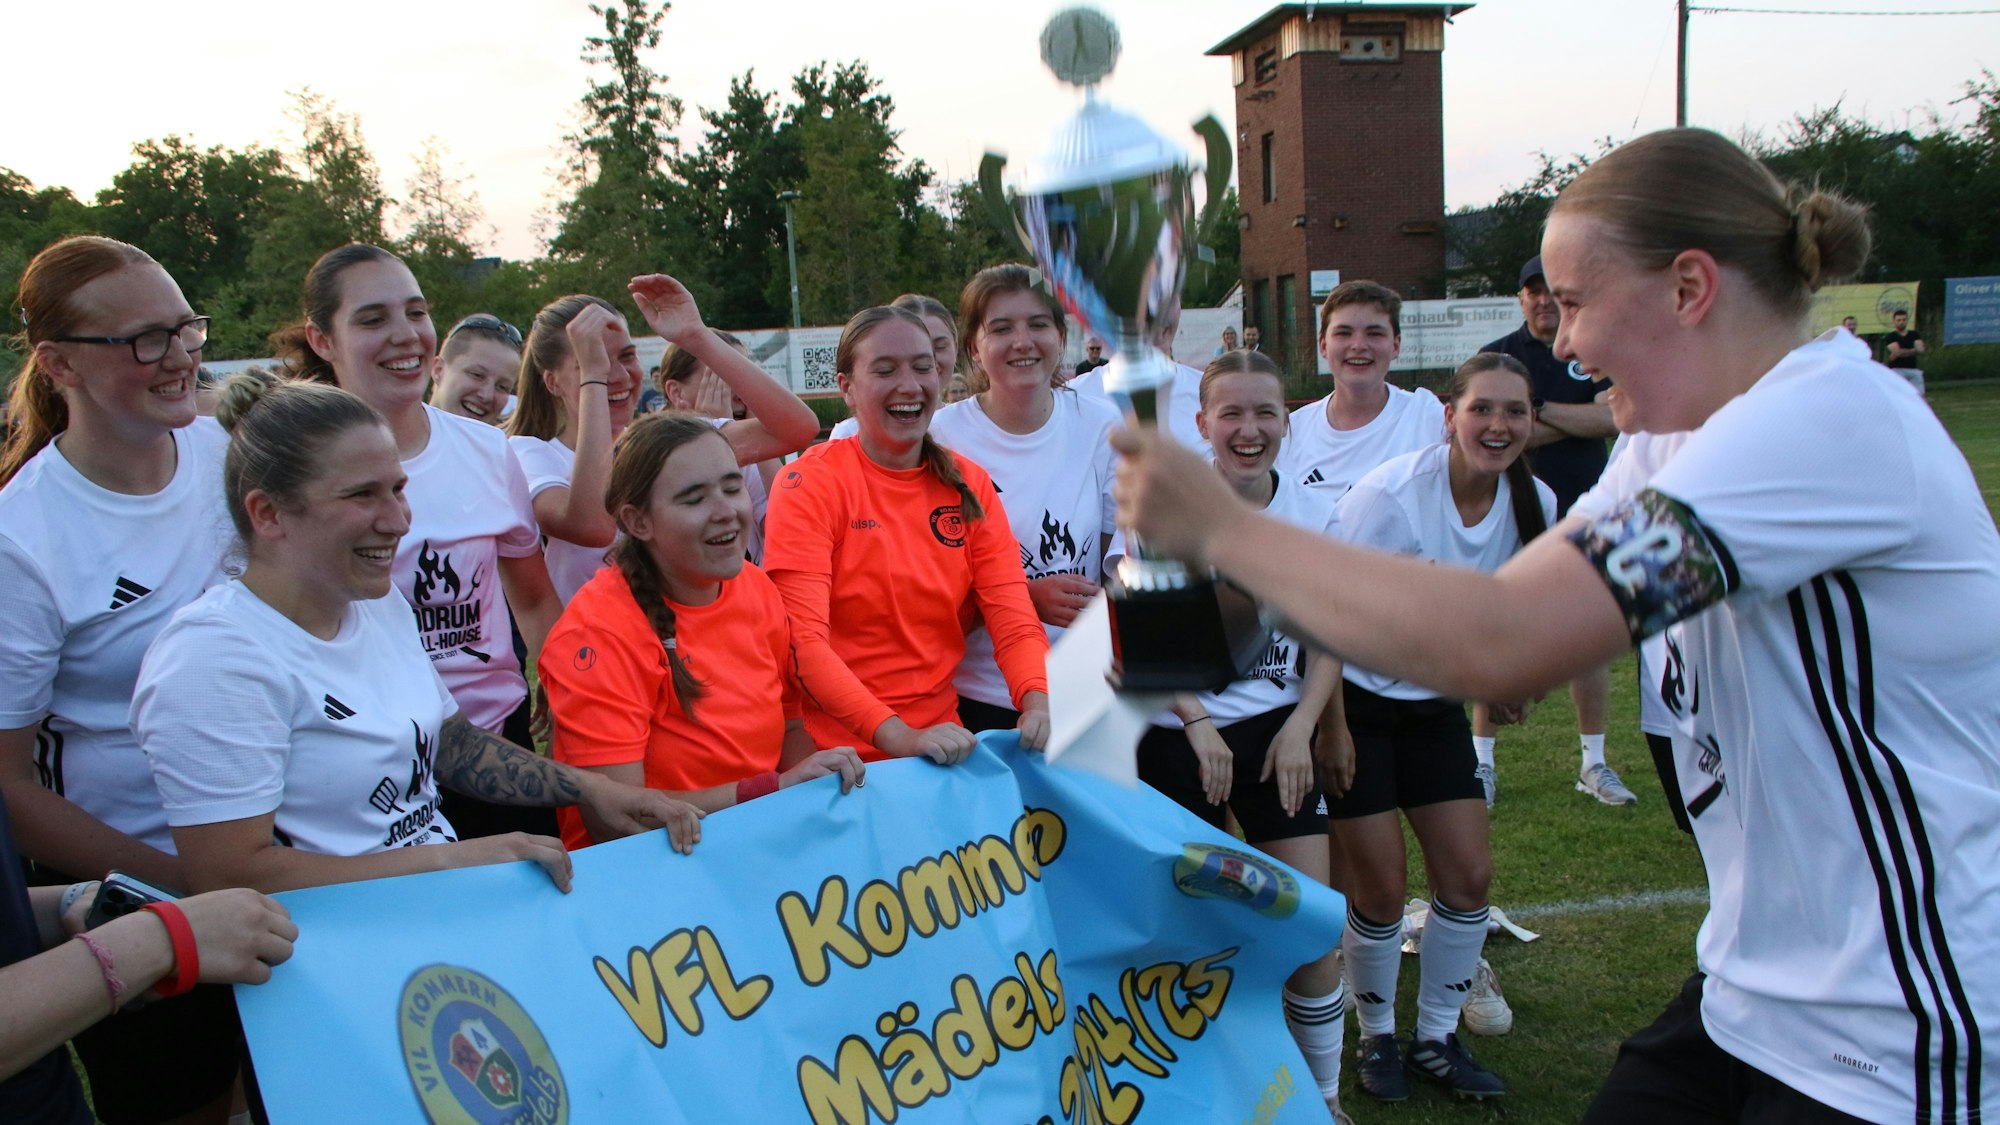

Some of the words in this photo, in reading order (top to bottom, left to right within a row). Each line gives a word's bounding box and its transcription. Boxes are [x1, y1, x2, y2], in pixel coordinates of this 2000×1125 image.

[1955, 283, 1990, 294] Oliver
[408, 974, 496, 1028] KOMMERN
[797, 948, 1065, 1125] Mädels
[1833, 1052, 1879, 1073] AEROREADY
